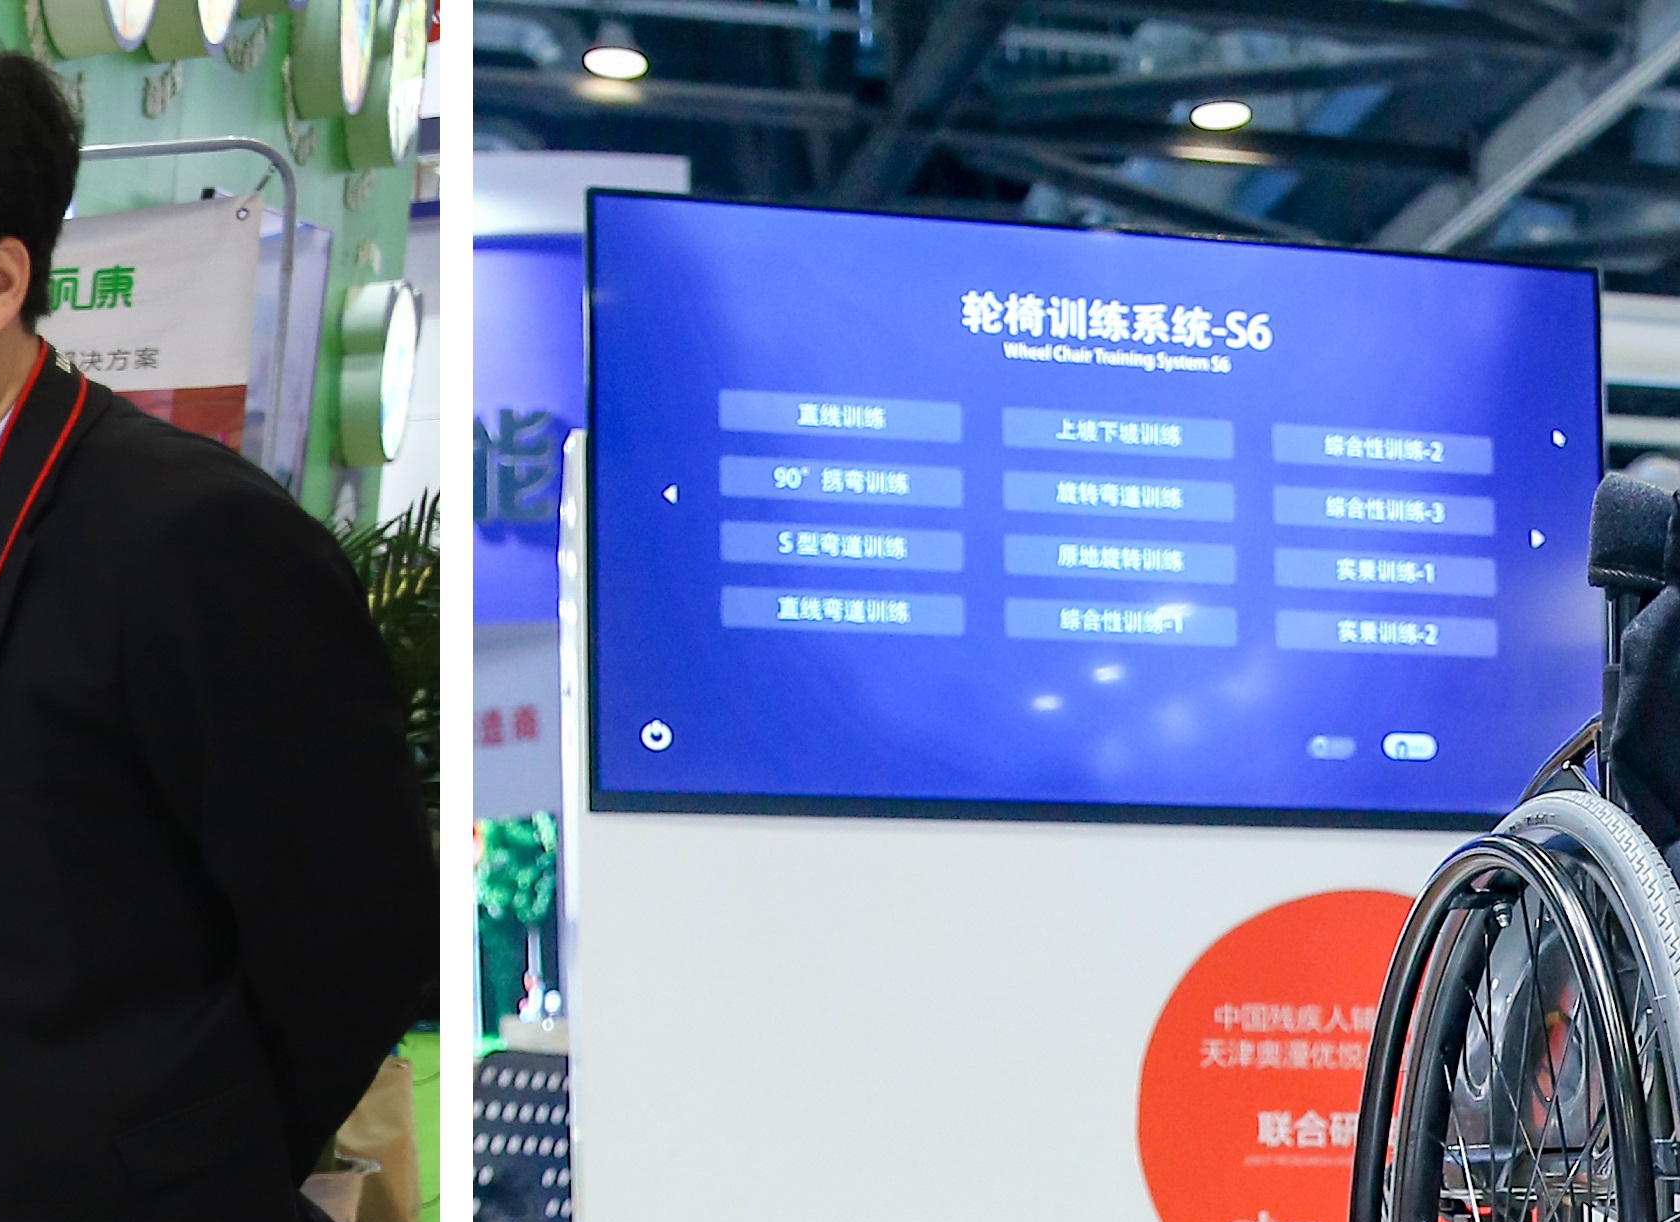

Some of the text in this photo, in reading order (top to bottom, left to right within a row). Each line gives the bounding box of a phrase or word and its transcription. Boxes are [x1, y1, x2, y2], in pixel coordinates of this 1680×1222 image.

[960, 289, 1274, 351] 轮椅训练系统-S6
[1002, 340, 1232, 374] Wheel Chair Training System S6
[797, 402, 887, 430] 直线训练
[1055, 417, 1183, 448] 上坡下坡训练
[1324, 433, 1445, 464] 综合性训练-2
[1056, 480, 1184, 509] 旋转弯道训练
[1325, 495, 1446, 524] 综合性训练-3
[796, 531, 908, 560] 型弯道训练
[1057, 543, 1185, 573] 原地旋转训练
[1336, 557, 1436, 585] 实景训练-1
[777, 595, 911, 625] 直线弯道训练
[1060, 607, 1184, 635] 综合性训练-1
[1337, 619, 1440, 646] 实景训练-2
[1200, 1037, 1370, 1072] 天津奥漫优悦
